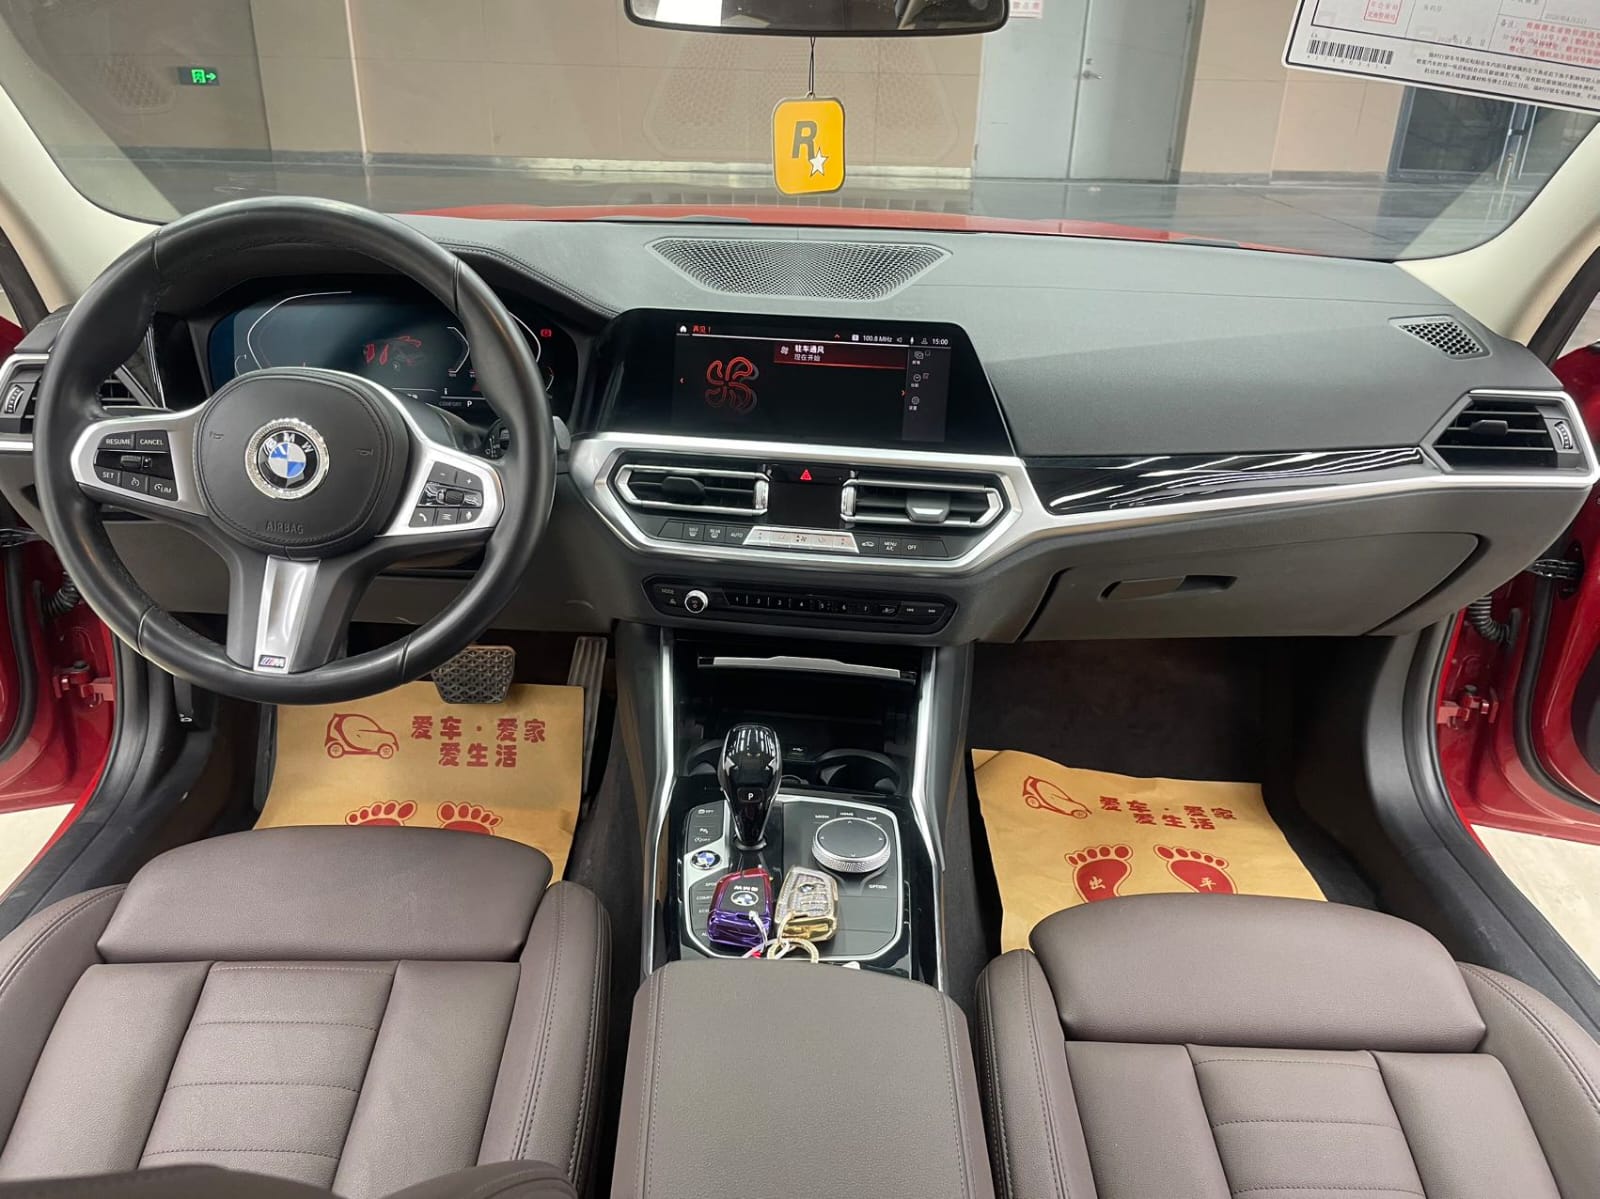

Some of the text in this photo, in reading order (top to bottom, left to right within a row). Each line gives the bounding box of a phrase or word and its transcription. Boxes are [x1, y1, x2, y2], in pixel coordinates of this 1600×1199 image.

[792, 120, 818, 161] R
[931, 338, 949, 346] 15:00
[139, 438, 164, 446] CANCEL
[264, 432, 315, 456] BMW
[102, 471, 114, 479] SET
[264, 519, 304, 535] AIRBAG
[438, 742, 518, 768] 爱生活
[1132, 812, 1216, 831] 爱生活
[1088, 875, 1107, 890] 出
[1199, 876, 1218, 890] 平
